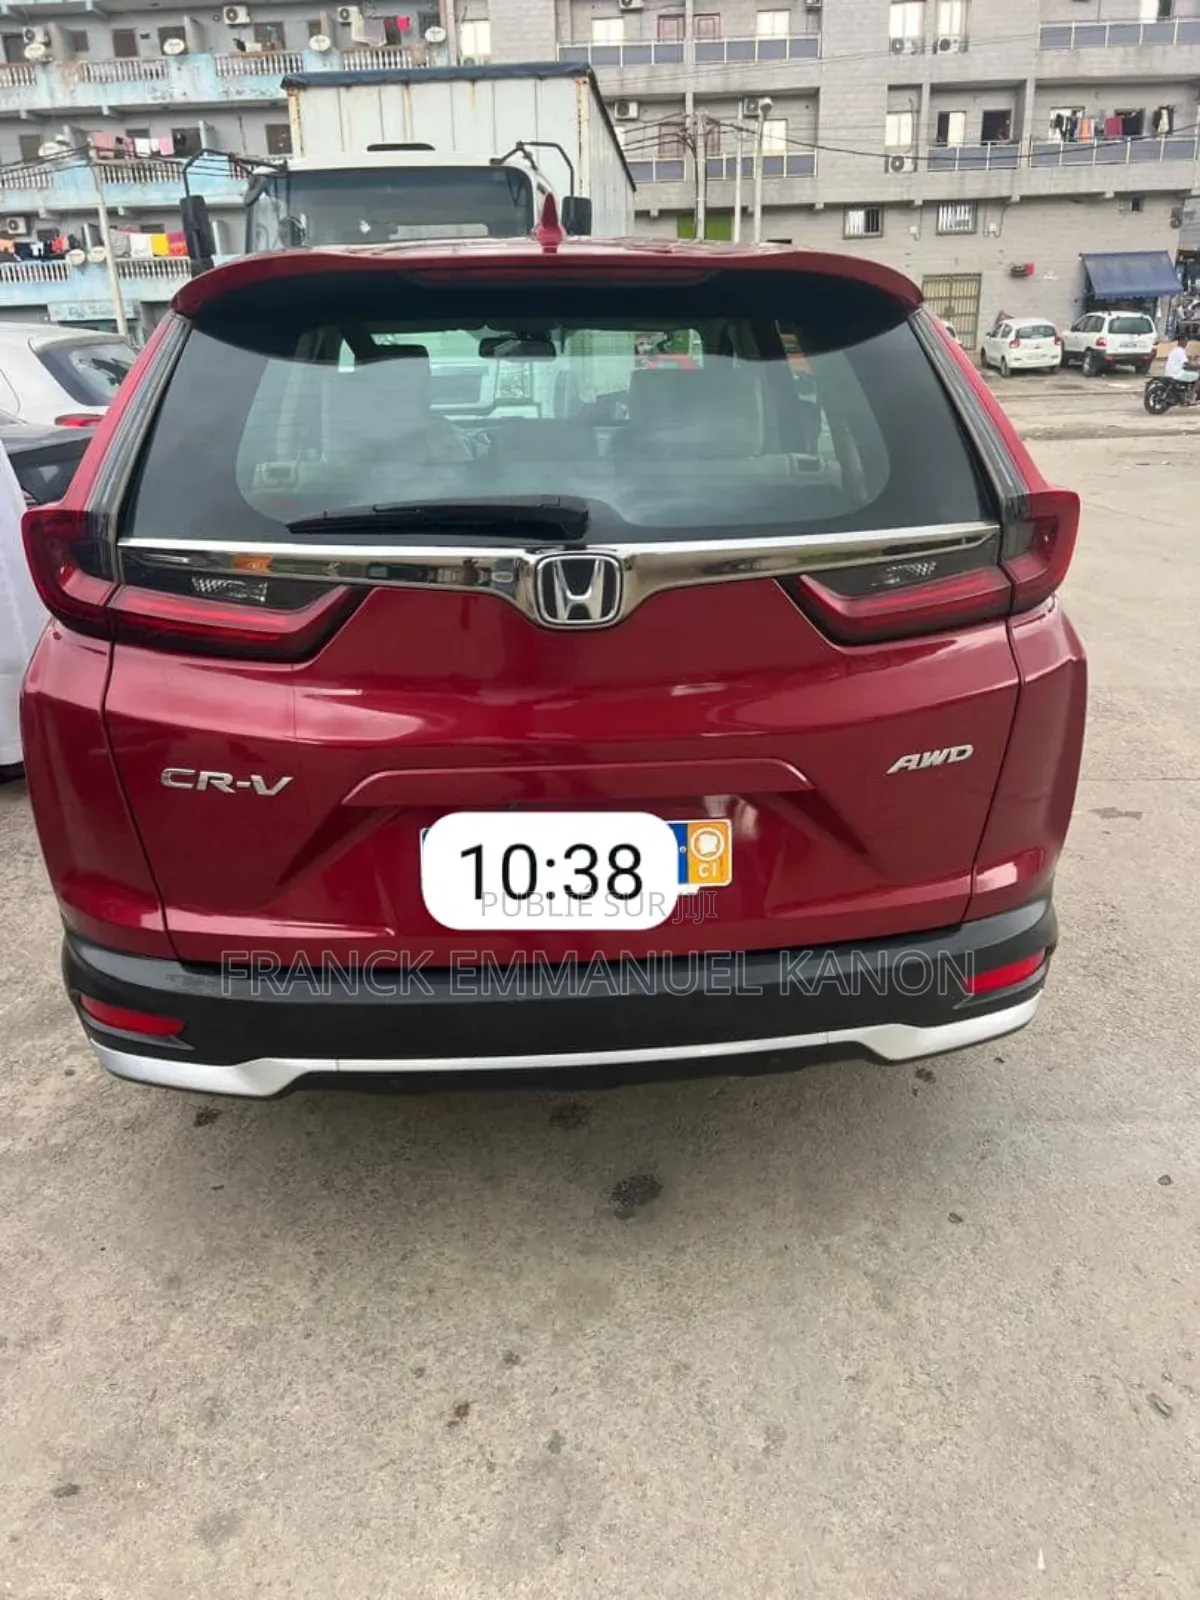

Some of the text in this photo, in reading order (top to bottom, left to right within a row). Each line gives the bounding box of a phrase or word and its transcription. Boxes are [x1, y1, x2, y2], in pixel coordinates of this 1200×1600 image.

[886, 744, 974, 774] AWD
[160, 767, 294, 796] CR-V
[698, 862, 717, 878] CI
